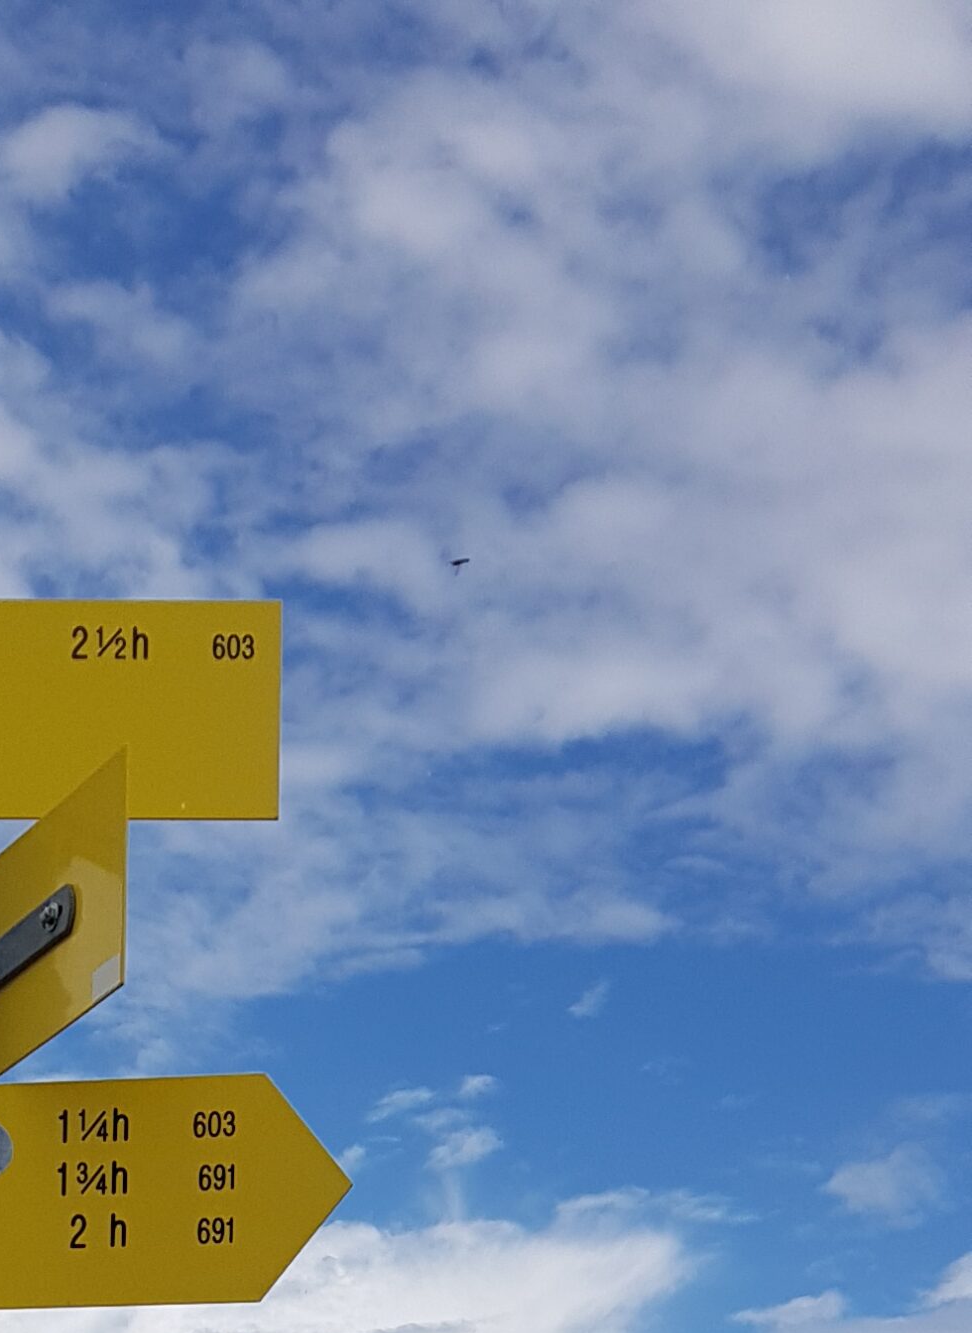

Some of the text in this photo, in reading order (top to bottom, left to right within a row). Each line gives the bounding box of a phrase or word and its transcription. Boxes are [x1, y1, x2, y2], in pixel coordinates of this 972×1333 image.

[212, 633, 255, 660] 603
[192, 1110, 236, 1139] 603
[197, 1163, 236, 1192] 691
[69, 1213, 87, 1249] 2
[109, 1213, 127, 1248] h
[196, 1217, 235, 1245] 691
